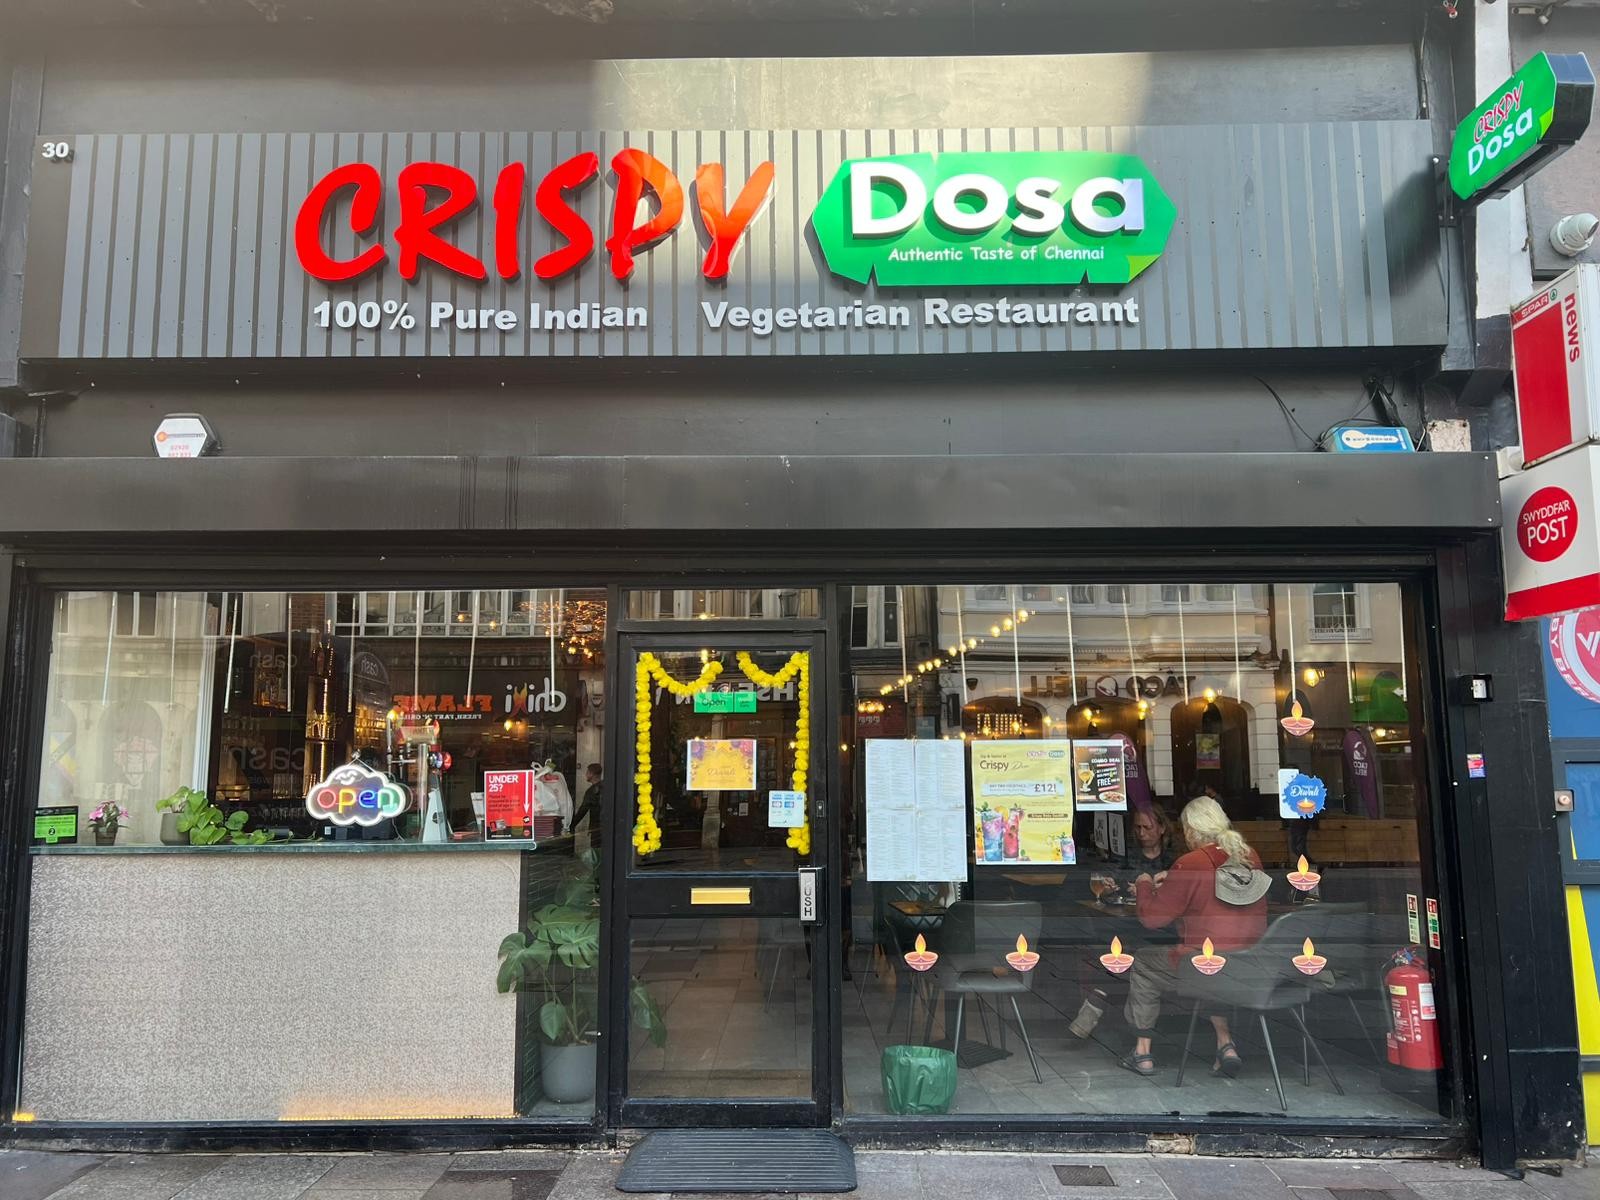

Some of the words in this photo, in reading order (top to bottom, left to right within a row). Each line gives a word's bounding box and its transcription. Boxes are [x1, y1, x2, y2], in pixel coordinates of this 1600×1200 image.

[1474, 79, 1524, 144] CRISPY
[41, 142, 69, 158] 30
[1468, 107, 1533, 176] Dosa
[849, 161, 1145, 238] Dosa
[294, 147, 776, 281] CRISPY
[888, 247, 963, 262] Authentic
[970, 246, 1014, 261] Taste
[1020, 246, 1039, 261] of
[1044, 246, 1105, 261] Chennai
[313, 300, 416, 330] 100%
[430, 301, 518, 330] Pure
[530, 302, 648, 330] Indian
[701, 300, 911, 335] Vegetarian
[924, 297, 1141, 326] Restaurant
[1520, 293, 1549, 318] SPAR
[1563, 292, 1581, 363] news
[1527, 515, 1569, 548] POST
[980, 760, 1009, 772] Crispy
[488, 775, 519, 784] UNDER
[488, 783, 504, 793] 25?
[1034, 783, 1057, 793] £12!
[1097, 777, 1112, 787] FREE
[317, 788, 396, 814] open
[49, 828, 56, 836] 2
